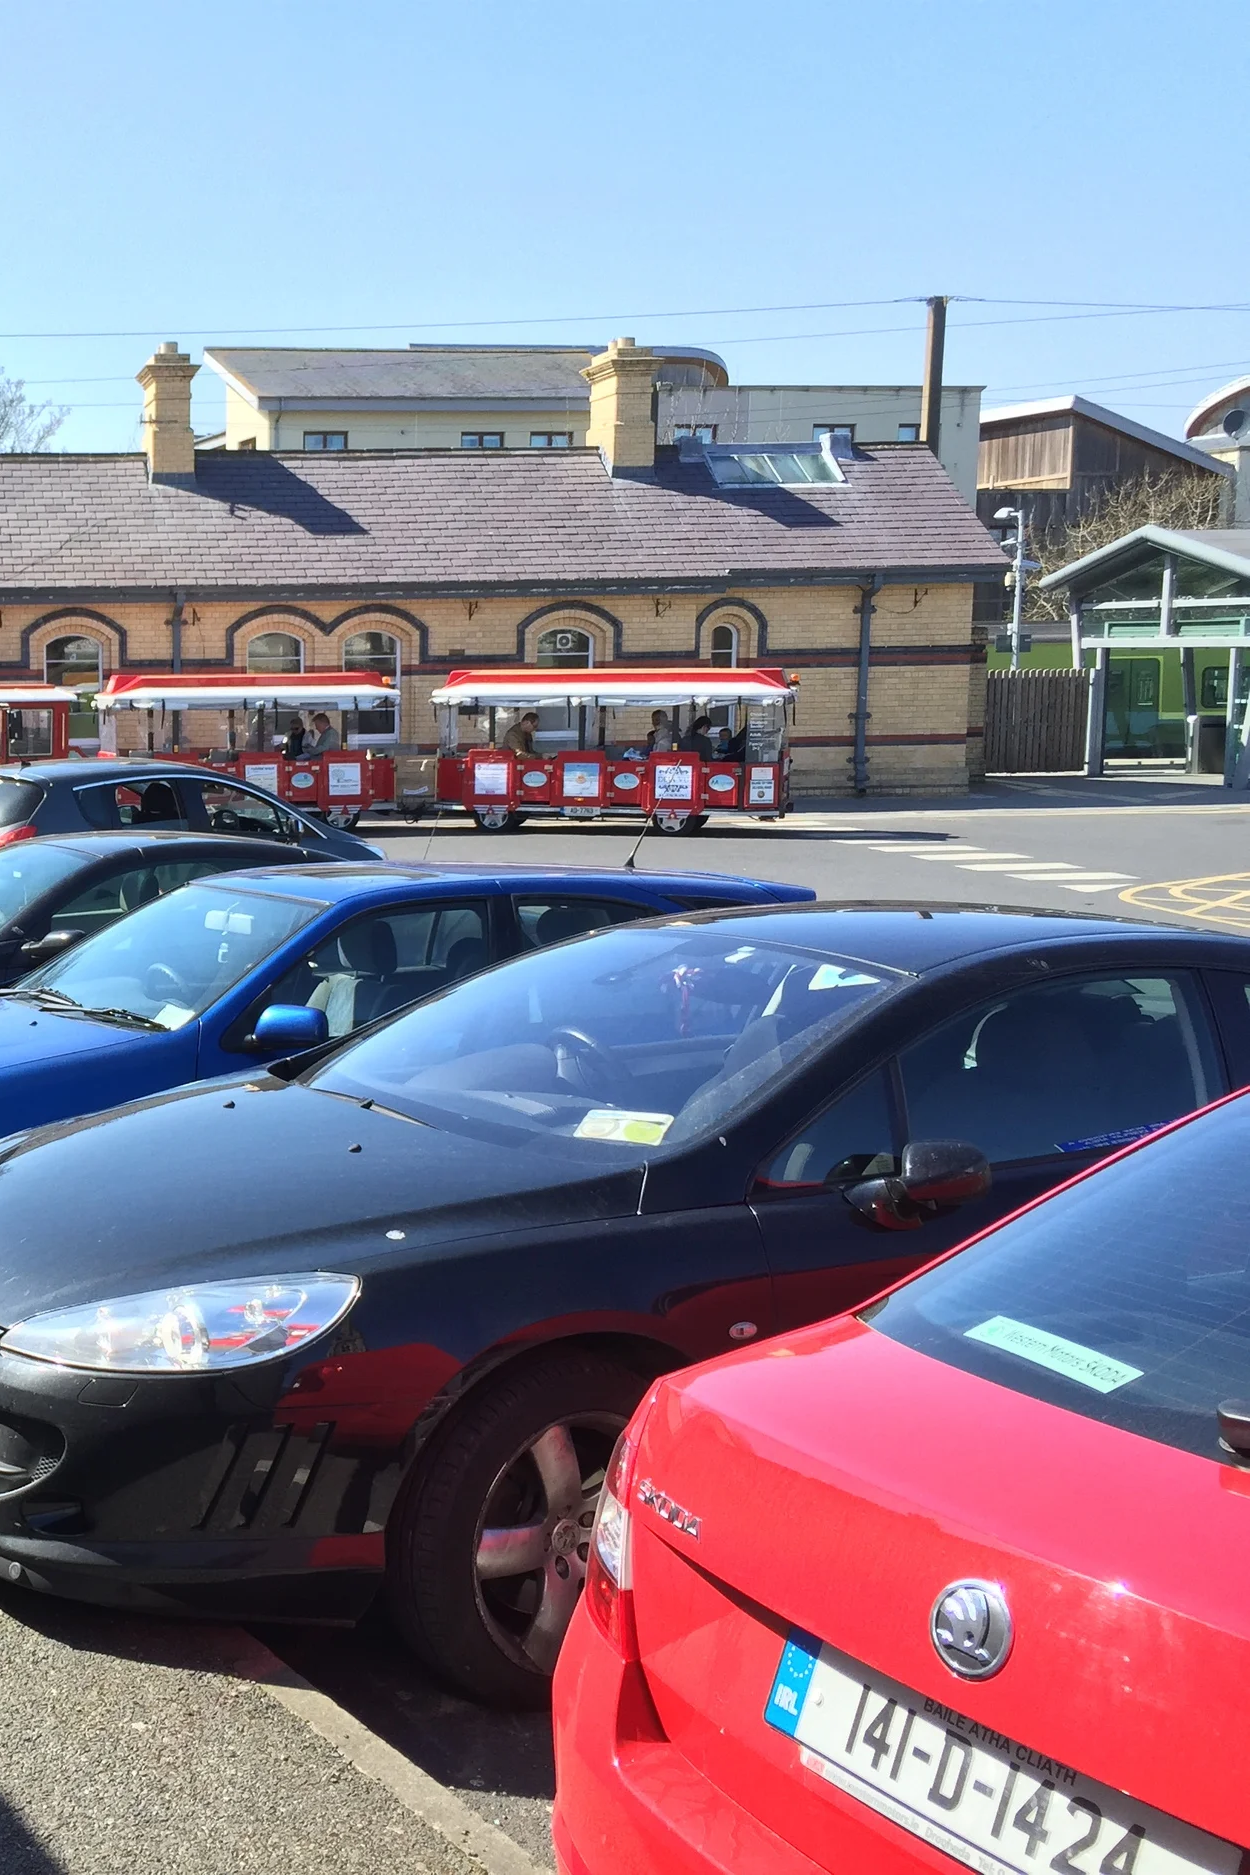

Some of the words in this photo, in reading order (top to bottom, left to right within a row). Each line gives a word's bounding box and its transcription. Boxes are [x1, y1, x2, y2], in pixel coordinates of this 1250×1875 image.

[1049, 1343, 1086, 1367] Motors
[773, 1683, 799, 1716] IRL
[923, 1698, 967, 1731] BAILE
[1015, 1745, 1078, 1787] CLIATH
[845, 1684, 1146, 1875] 141-D-1424
[924, 1826, 971, 1862] Drogheda
